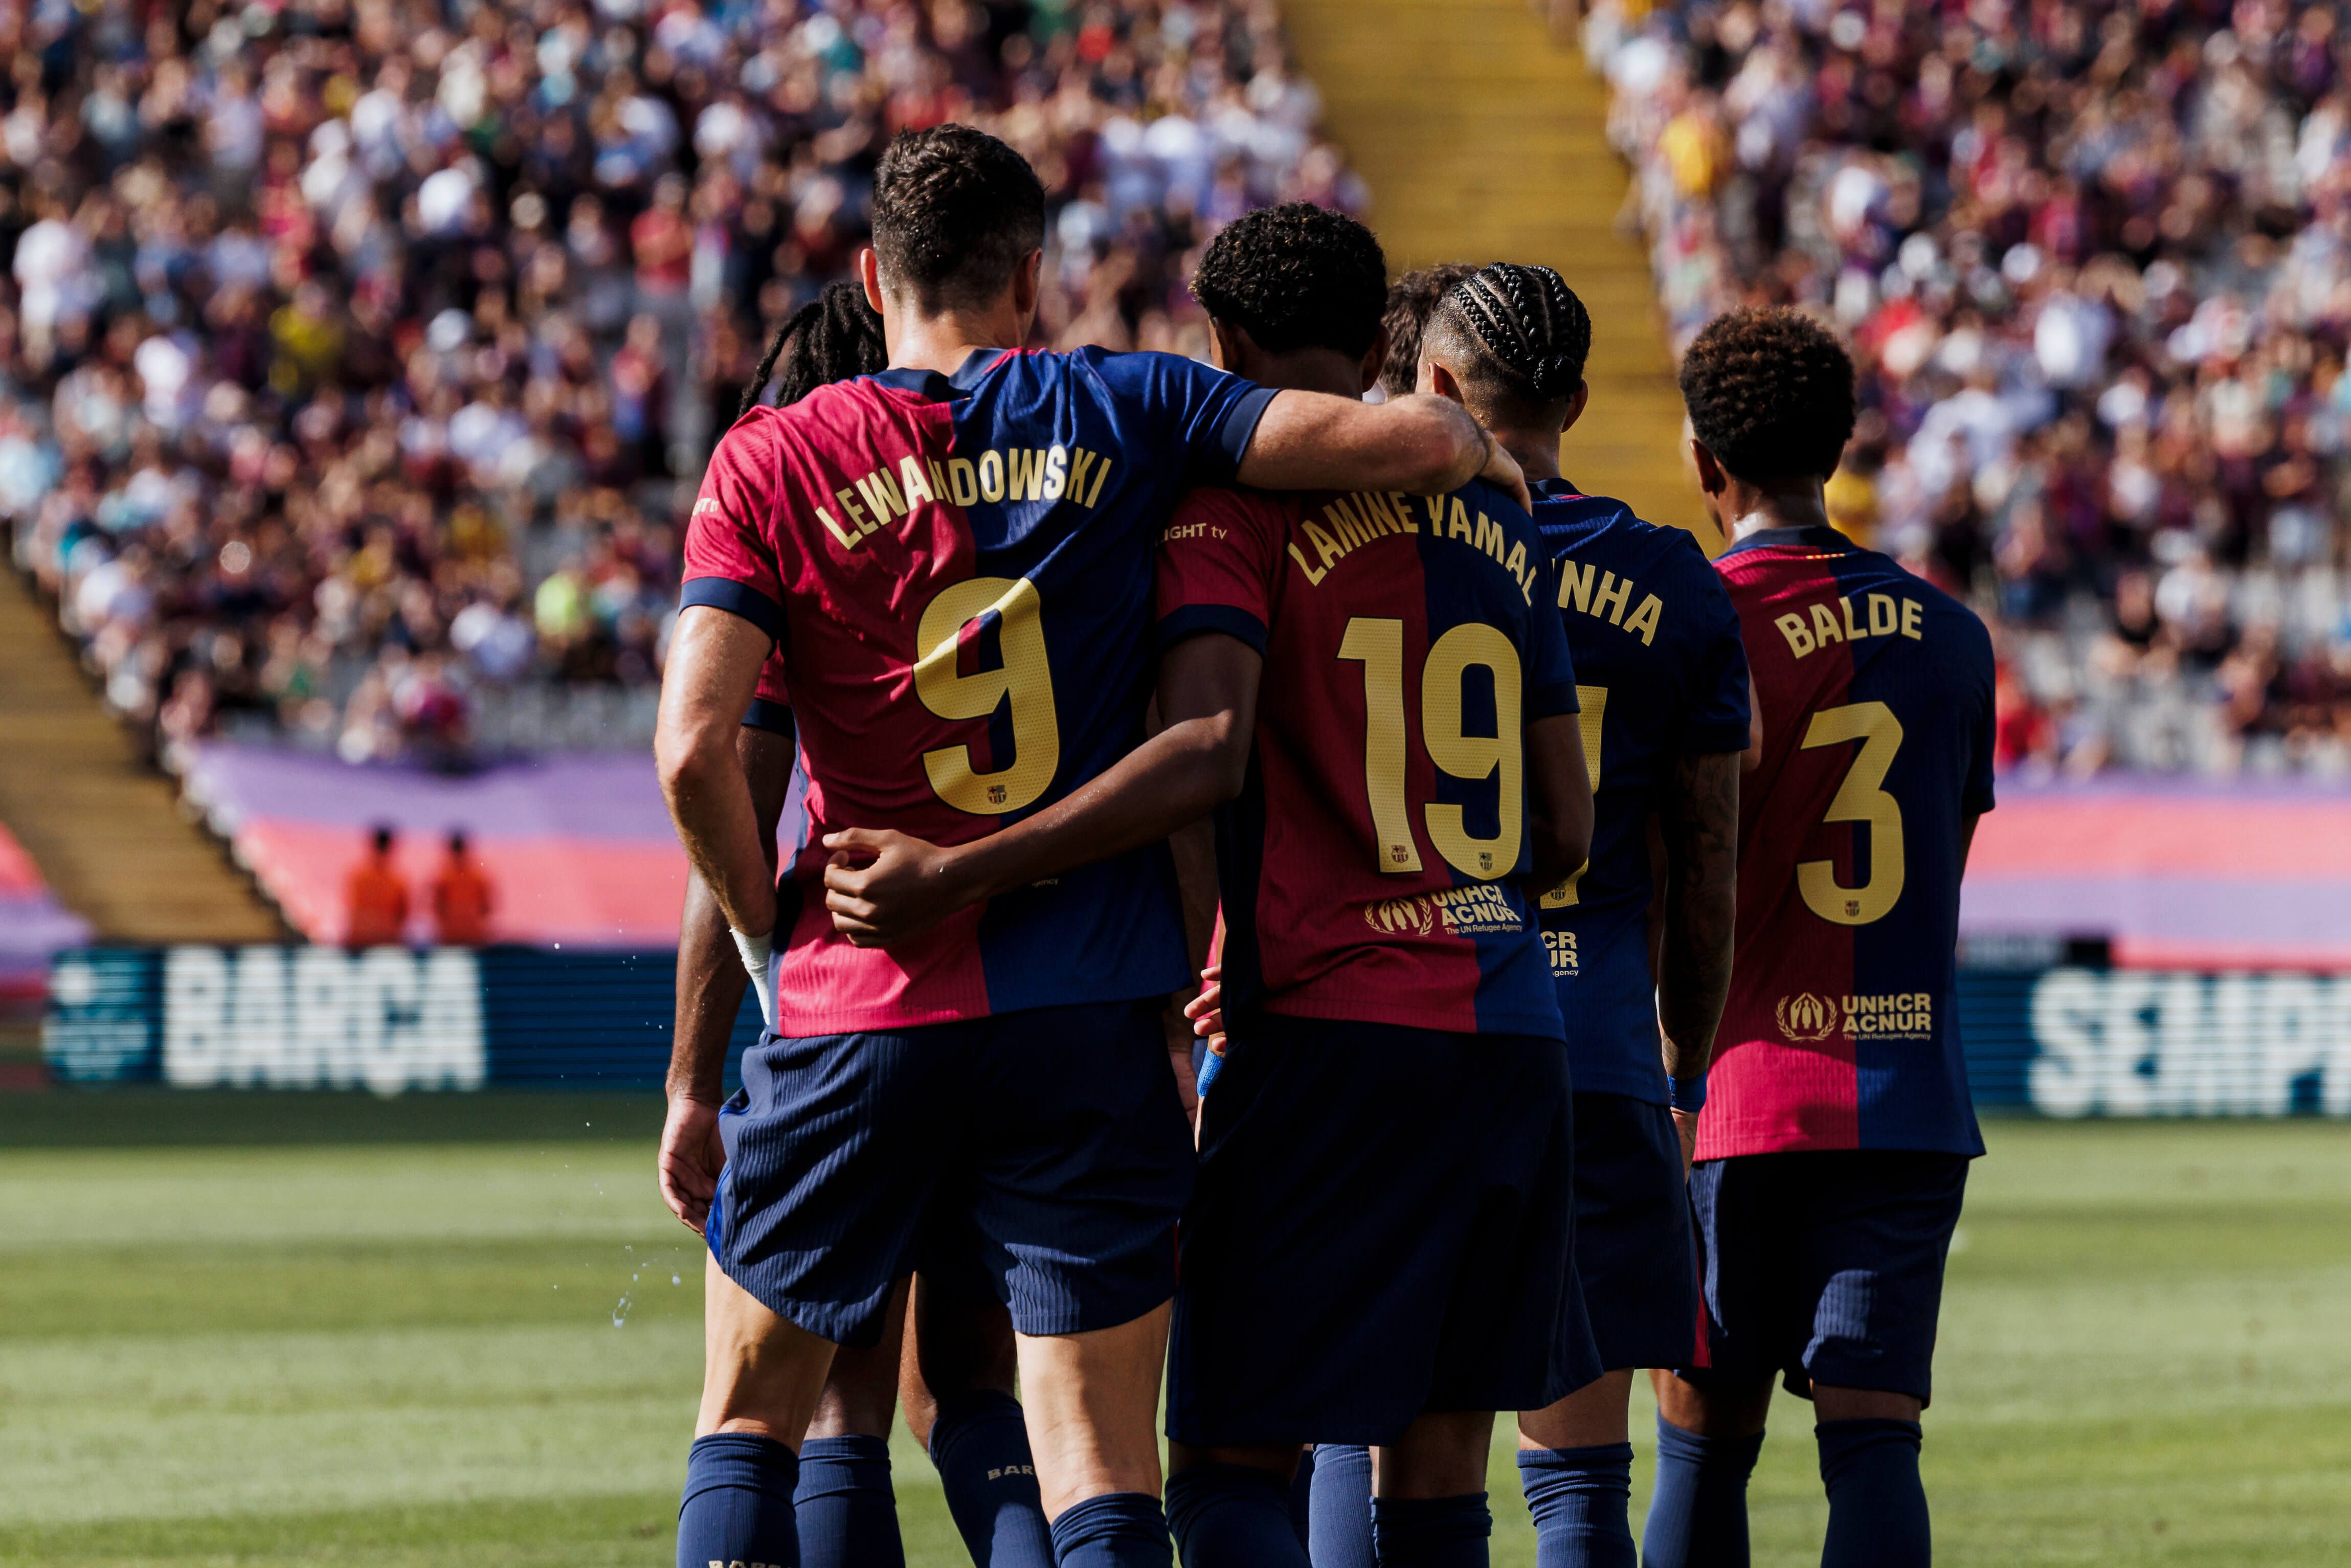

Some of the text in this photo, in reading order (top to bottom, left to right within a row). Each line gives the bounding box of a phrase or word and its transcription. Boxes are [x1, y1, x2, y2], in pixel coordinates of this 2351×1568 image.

[815, 445, 1112, 550] LEWANDOWSKI
[1159, 523, 1227, 542] IGHT tv
[1287, 492, 1536, 607] LAMINE YAMAL
[1552, 556, 1662, 646] NHA
[1774, 593, 1922, 659] BALDE
[912, 576, 1060, 814] 9
[1336, 616, 1522, 880] 19
[1797, 701, 1905, 926] 3
[1430, 885, 1507, 907] UNHCR
[1442, 903, 1521, 926] ACNUR
[1445, 923, 1522, 935] The UN Refugee Agency
[1842, 993, 1931, 1014] UNHCR
[1842, 1013, 1931, 1033] ACNUR
[1905, 1032, 1932, 1041] Agency
[987, 1465, 1034, 1481] BAR
